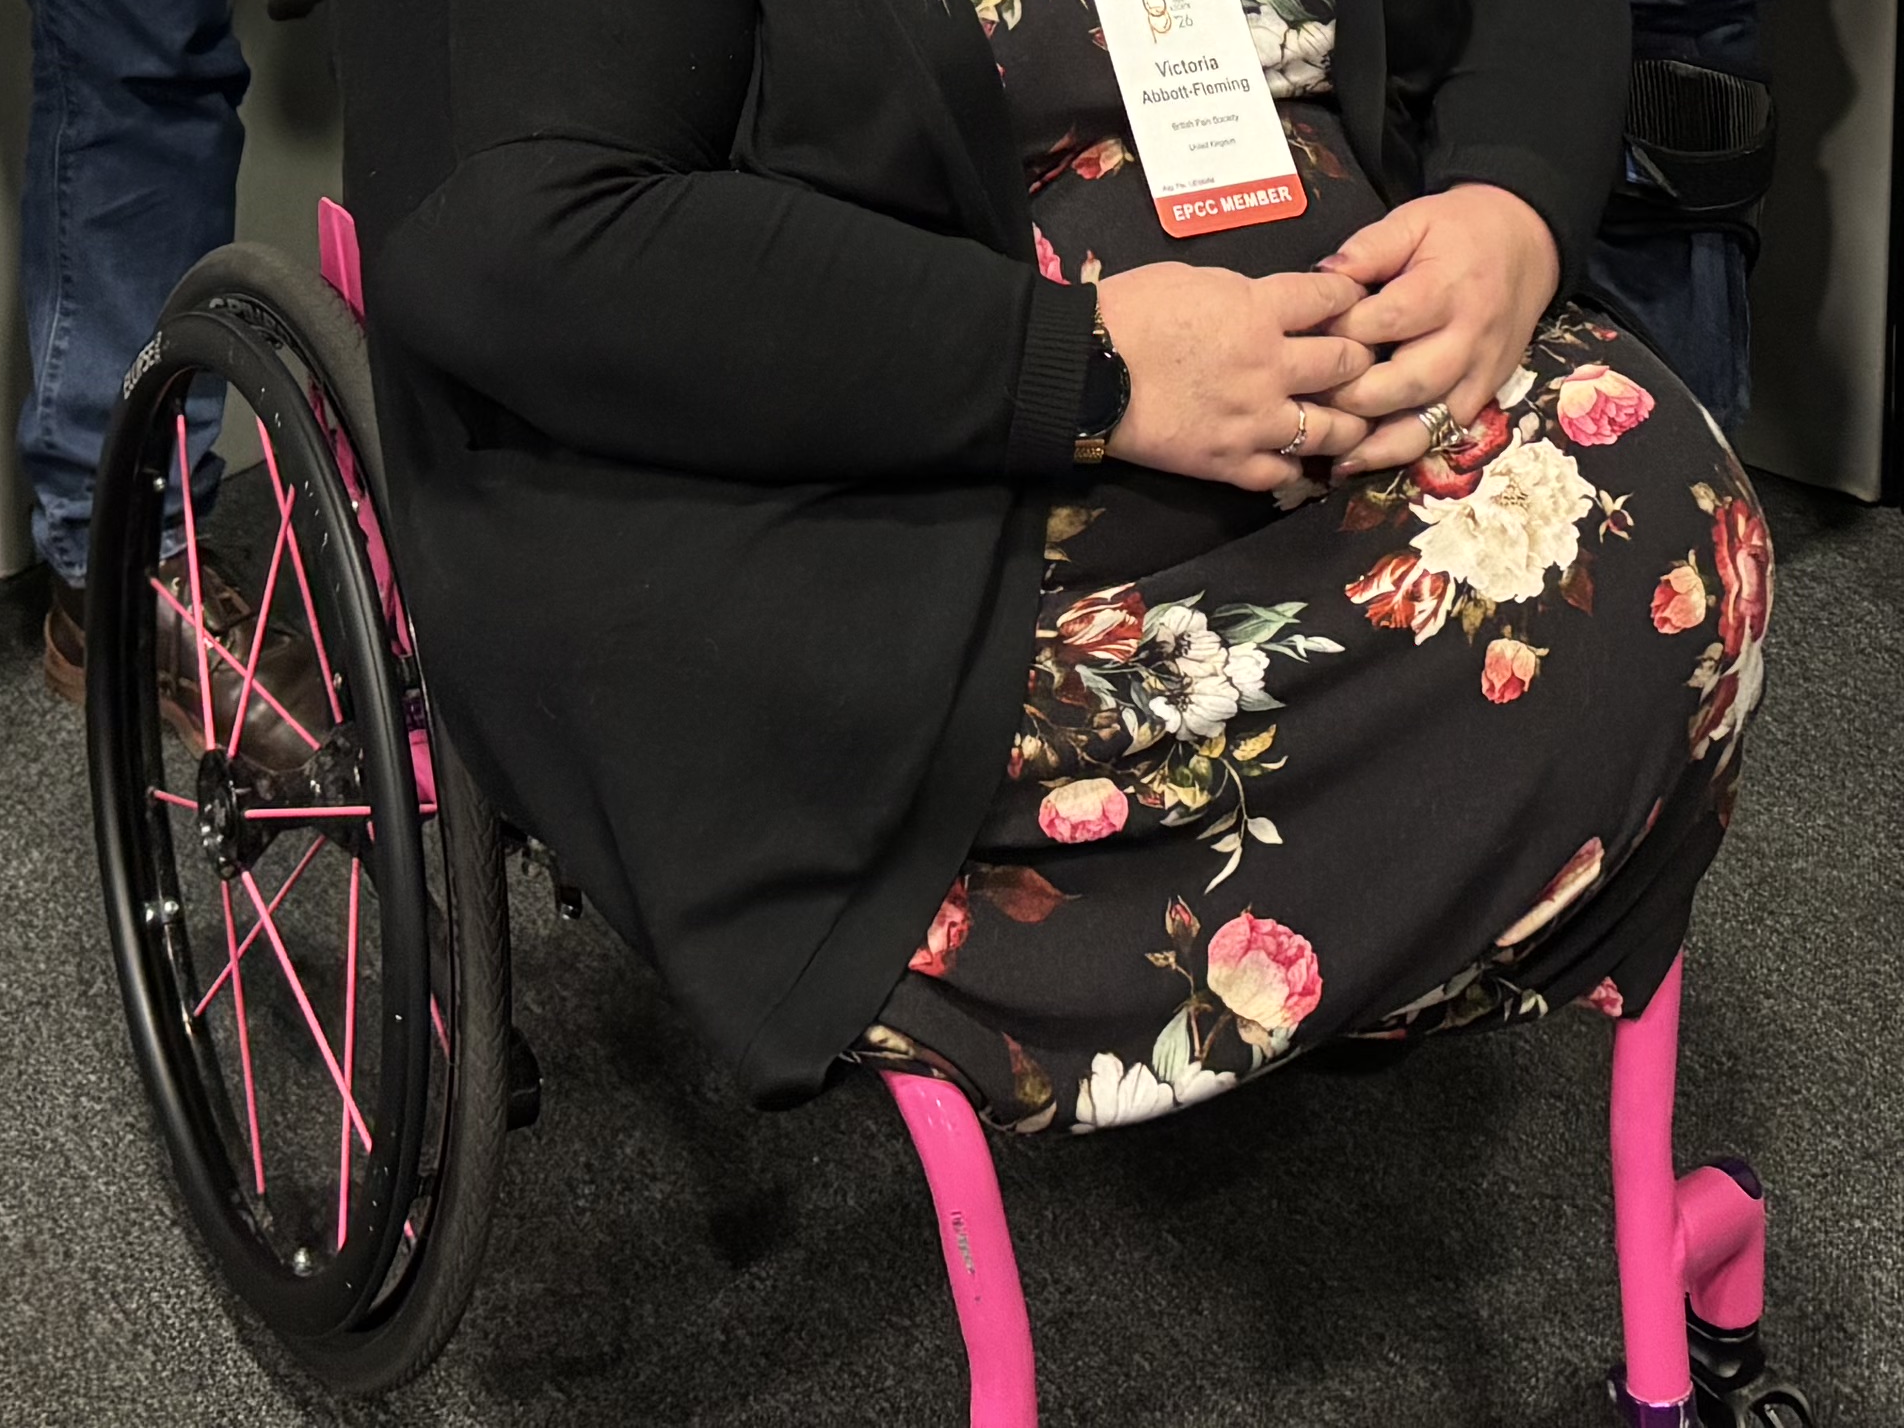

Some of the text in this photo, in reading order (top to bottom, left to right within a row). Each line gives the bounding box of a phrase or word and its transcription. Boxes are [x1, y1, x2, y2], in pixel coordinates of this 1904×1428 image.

[1155, 56, 1219, 77] Victoria
[1173, 187, 1292, 221] EPCC MEMBER
